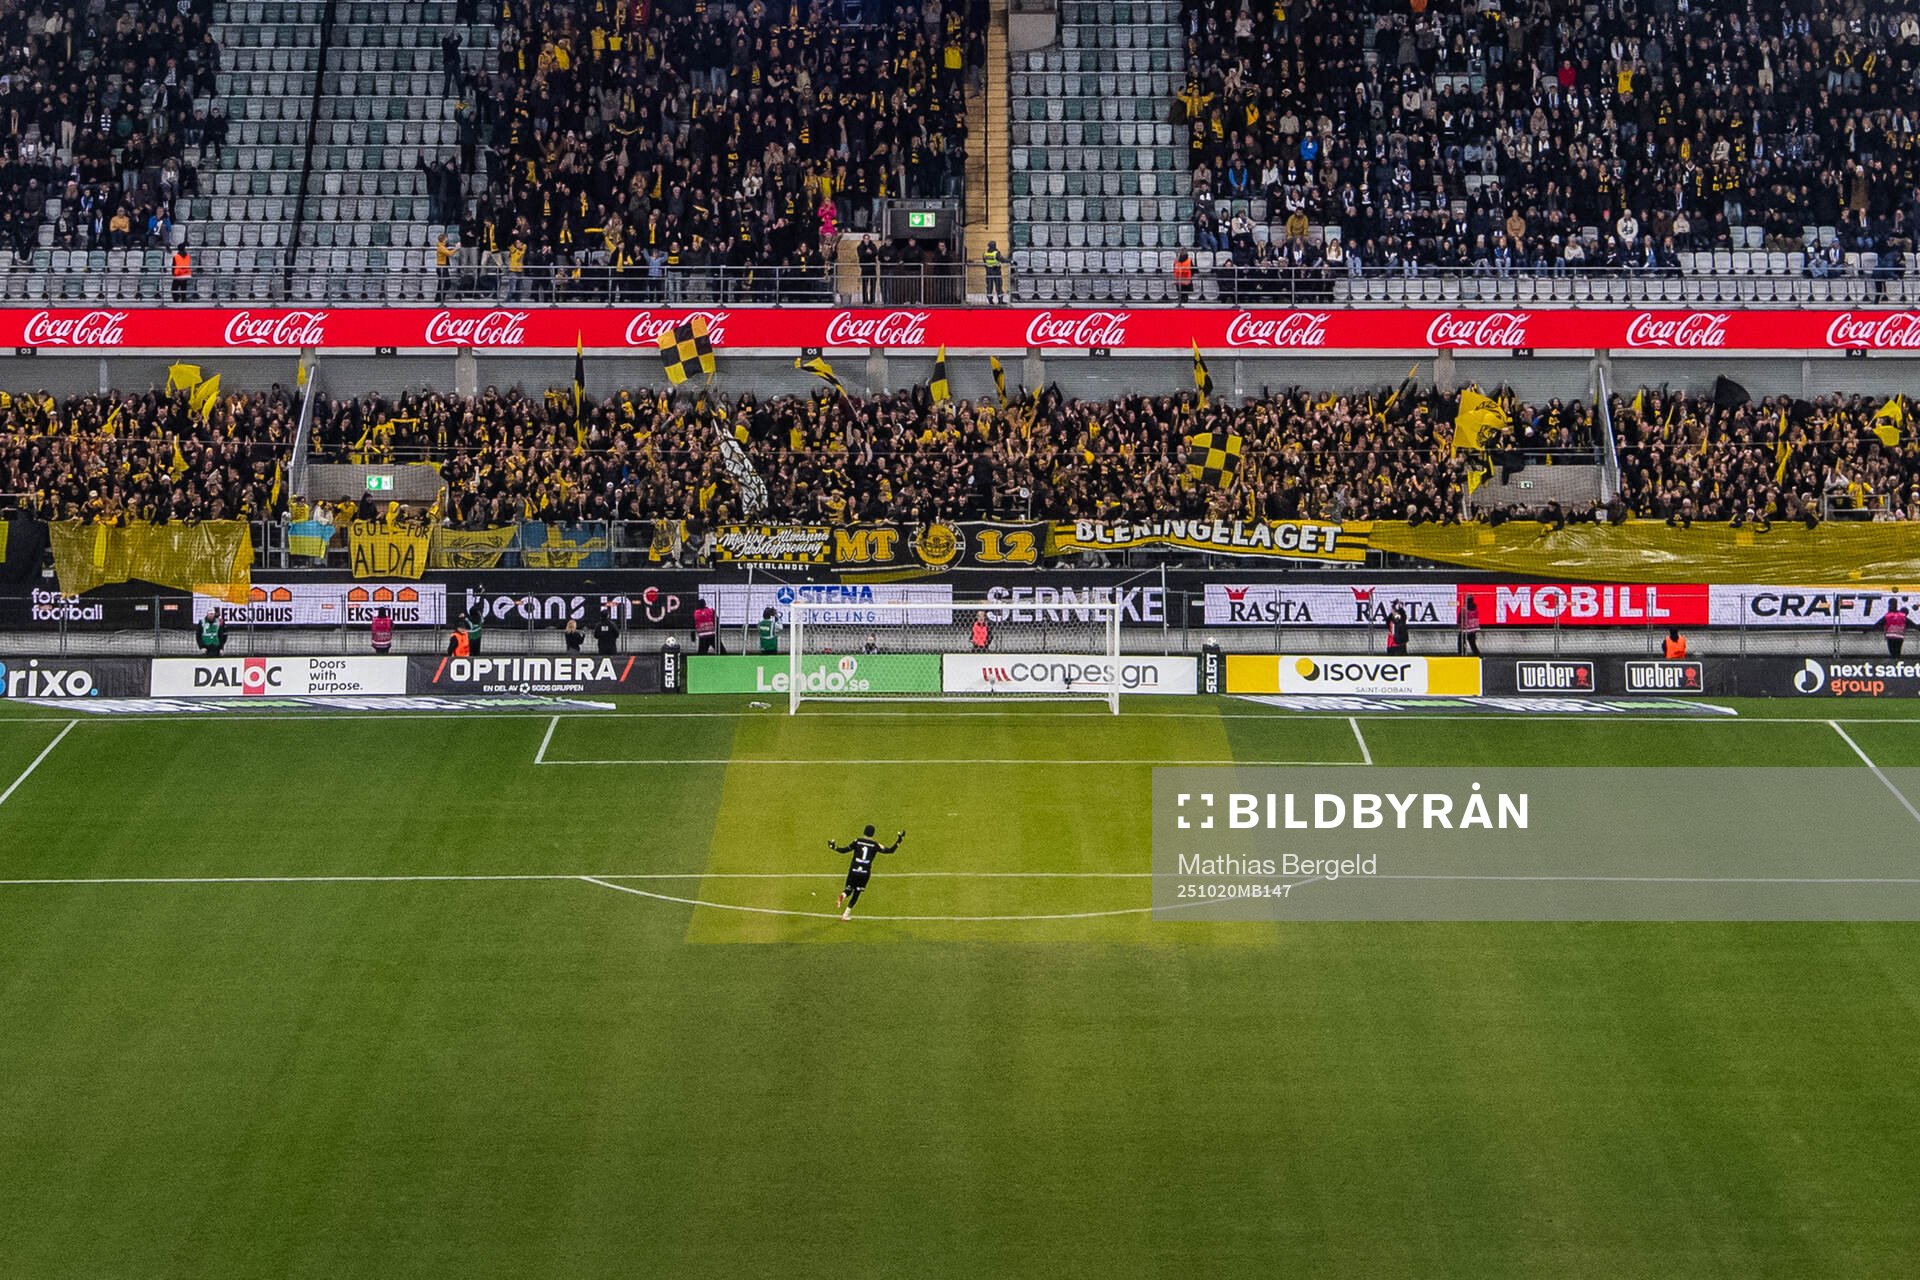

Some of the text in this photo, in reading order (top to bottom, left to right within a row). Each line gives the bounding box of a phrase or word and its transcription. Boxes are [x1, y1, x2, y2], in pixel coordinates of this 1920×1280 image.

[24, 311, 128, 345] Coca-Cola
[225, 311, 329, 345] Coca-Cola
[425, 311, 529, 345] Coca-Cola
[626, 311, 730, 345] Coca-la
[826, 311, 930, 345] Coca-Cola
[1026, 312, 1130, 346] Coca-Cola
[1226, 312, 1330, 346] Coca-Cola
[1427, 312, 1531, 346] Coca-Cola
[1627, 313, 1731, 347] Coca-Cola
[354, 543, 415, 576] ALDA
[834, 528, 899, 563] MT
[975, 528, 1038, 563] 12
[466, 588, 586, 620] beans
[798, 586, 874, 604] STENA
[986, 586, 1163, 622] SERNEKE
[1229, 601, 1313, 622] RASTA
[1496, 586, 1670, 623] MOBILL
[1751, 592, 1881, 617] CRAFT
[31, 604, 103, 620] football
[347, 605, 419, 621] EKSÖHUS
[0, 659, 99, 697] rixo.
[194, 665, 282, 688] DALOC
[309, 658, 346, 669] Doors
[309, 669, 336, 681] with
[450, 657, 617, 682] OPTIMERA
[665, 653, 674, 688] SELECT
[1206, 653, 1217, 693] SELECT
[1522, 663, 1574, 688] weber
[1631, 663, 1683, 688] weber
[1830, 662, 1874, 677] next
[308, 681, 363, 694] purpose.
[1830, 679, 1884, 696] group
[861, 846, 868, 860] 1
